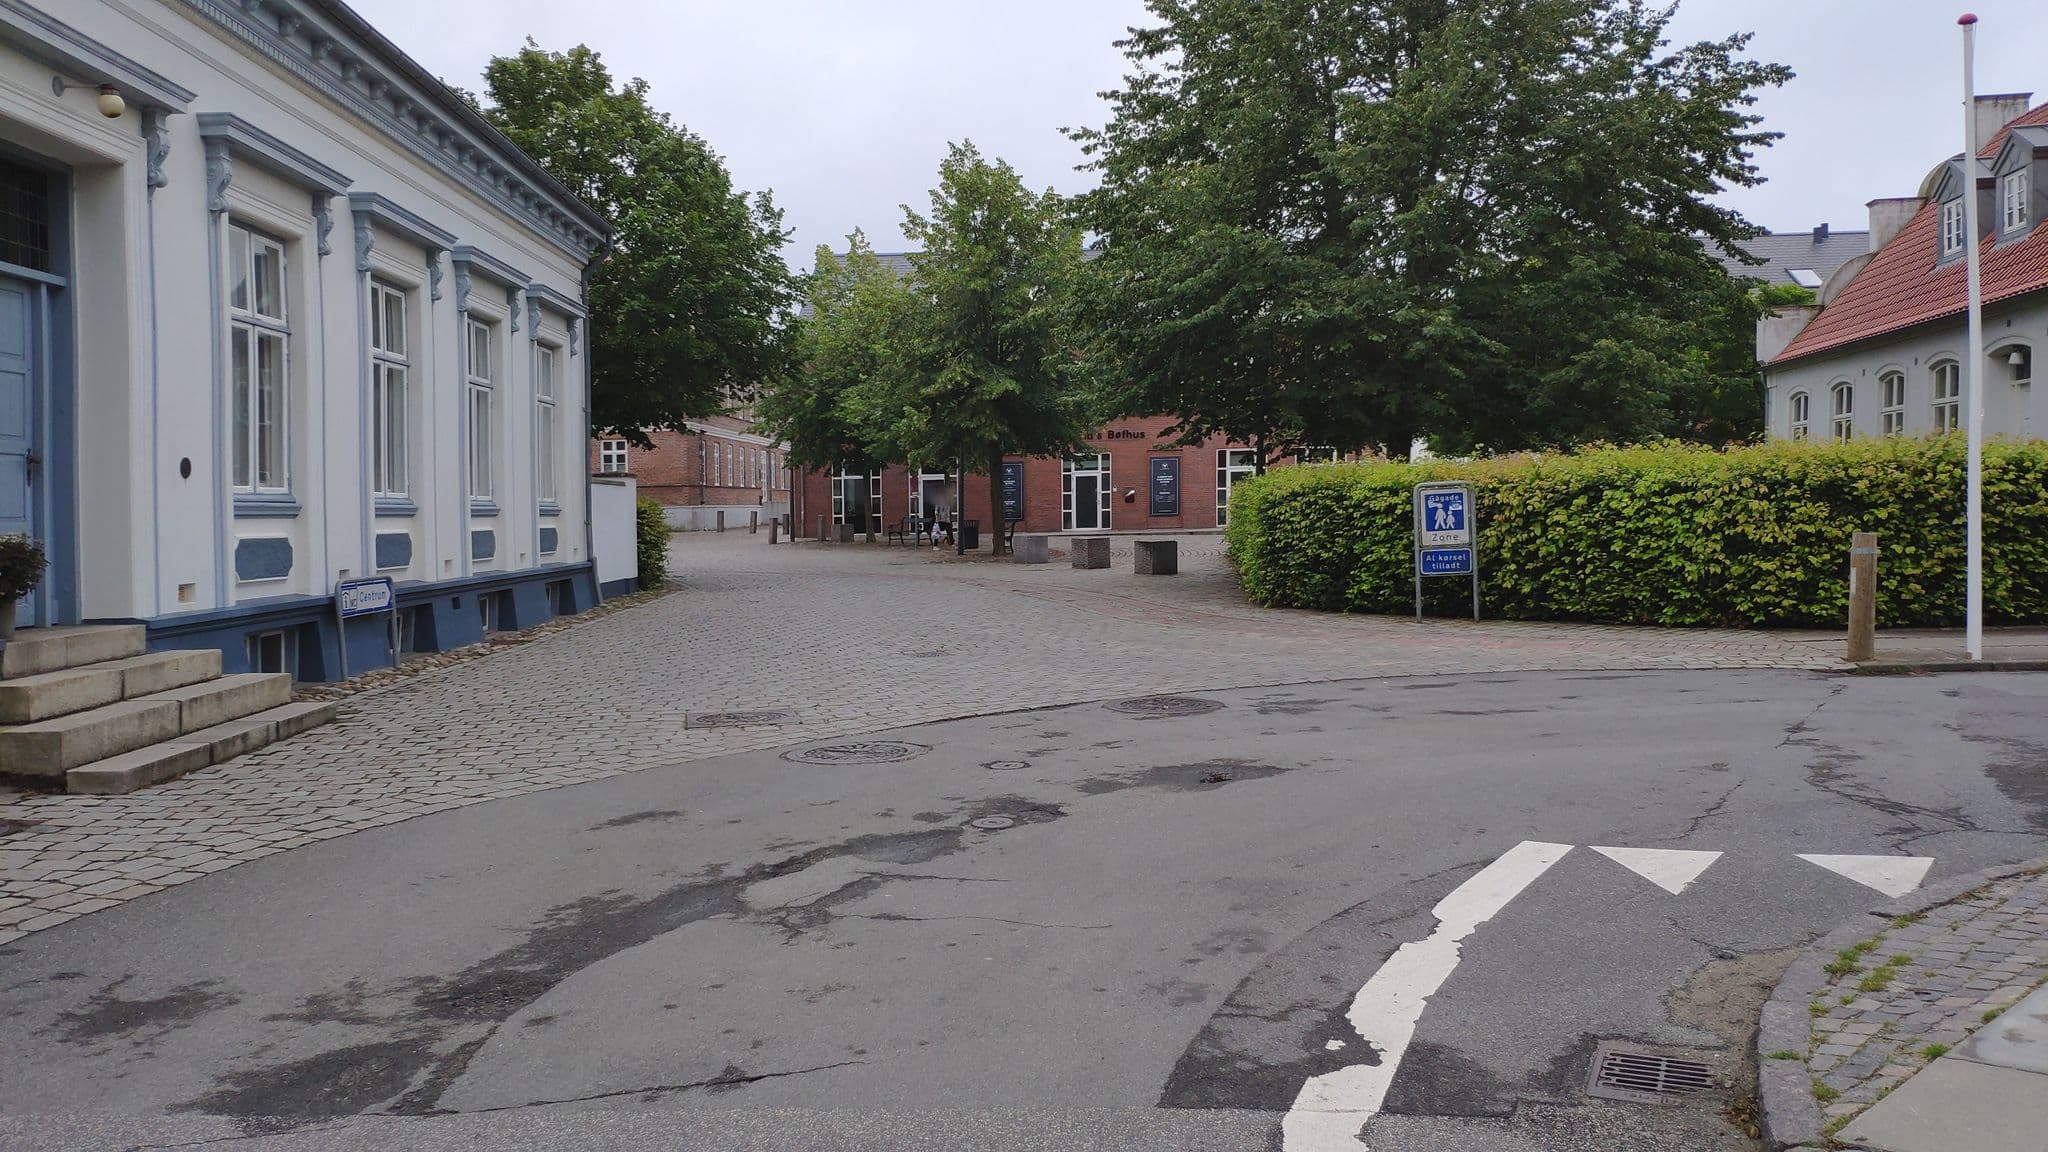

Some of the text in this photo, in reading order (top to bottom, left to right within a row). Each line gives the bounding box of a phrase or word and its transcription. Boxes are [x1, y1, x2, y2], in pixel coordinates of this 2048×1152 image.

[1107, 430, 1146, 440] Bøfhus
[1429, 494, 1460, 503] Gågade
[1431, 533, 1459, 542] Zone
[1438, 553, 1466, 561] kørsel
[360, 591, 386, 602] Centrum
